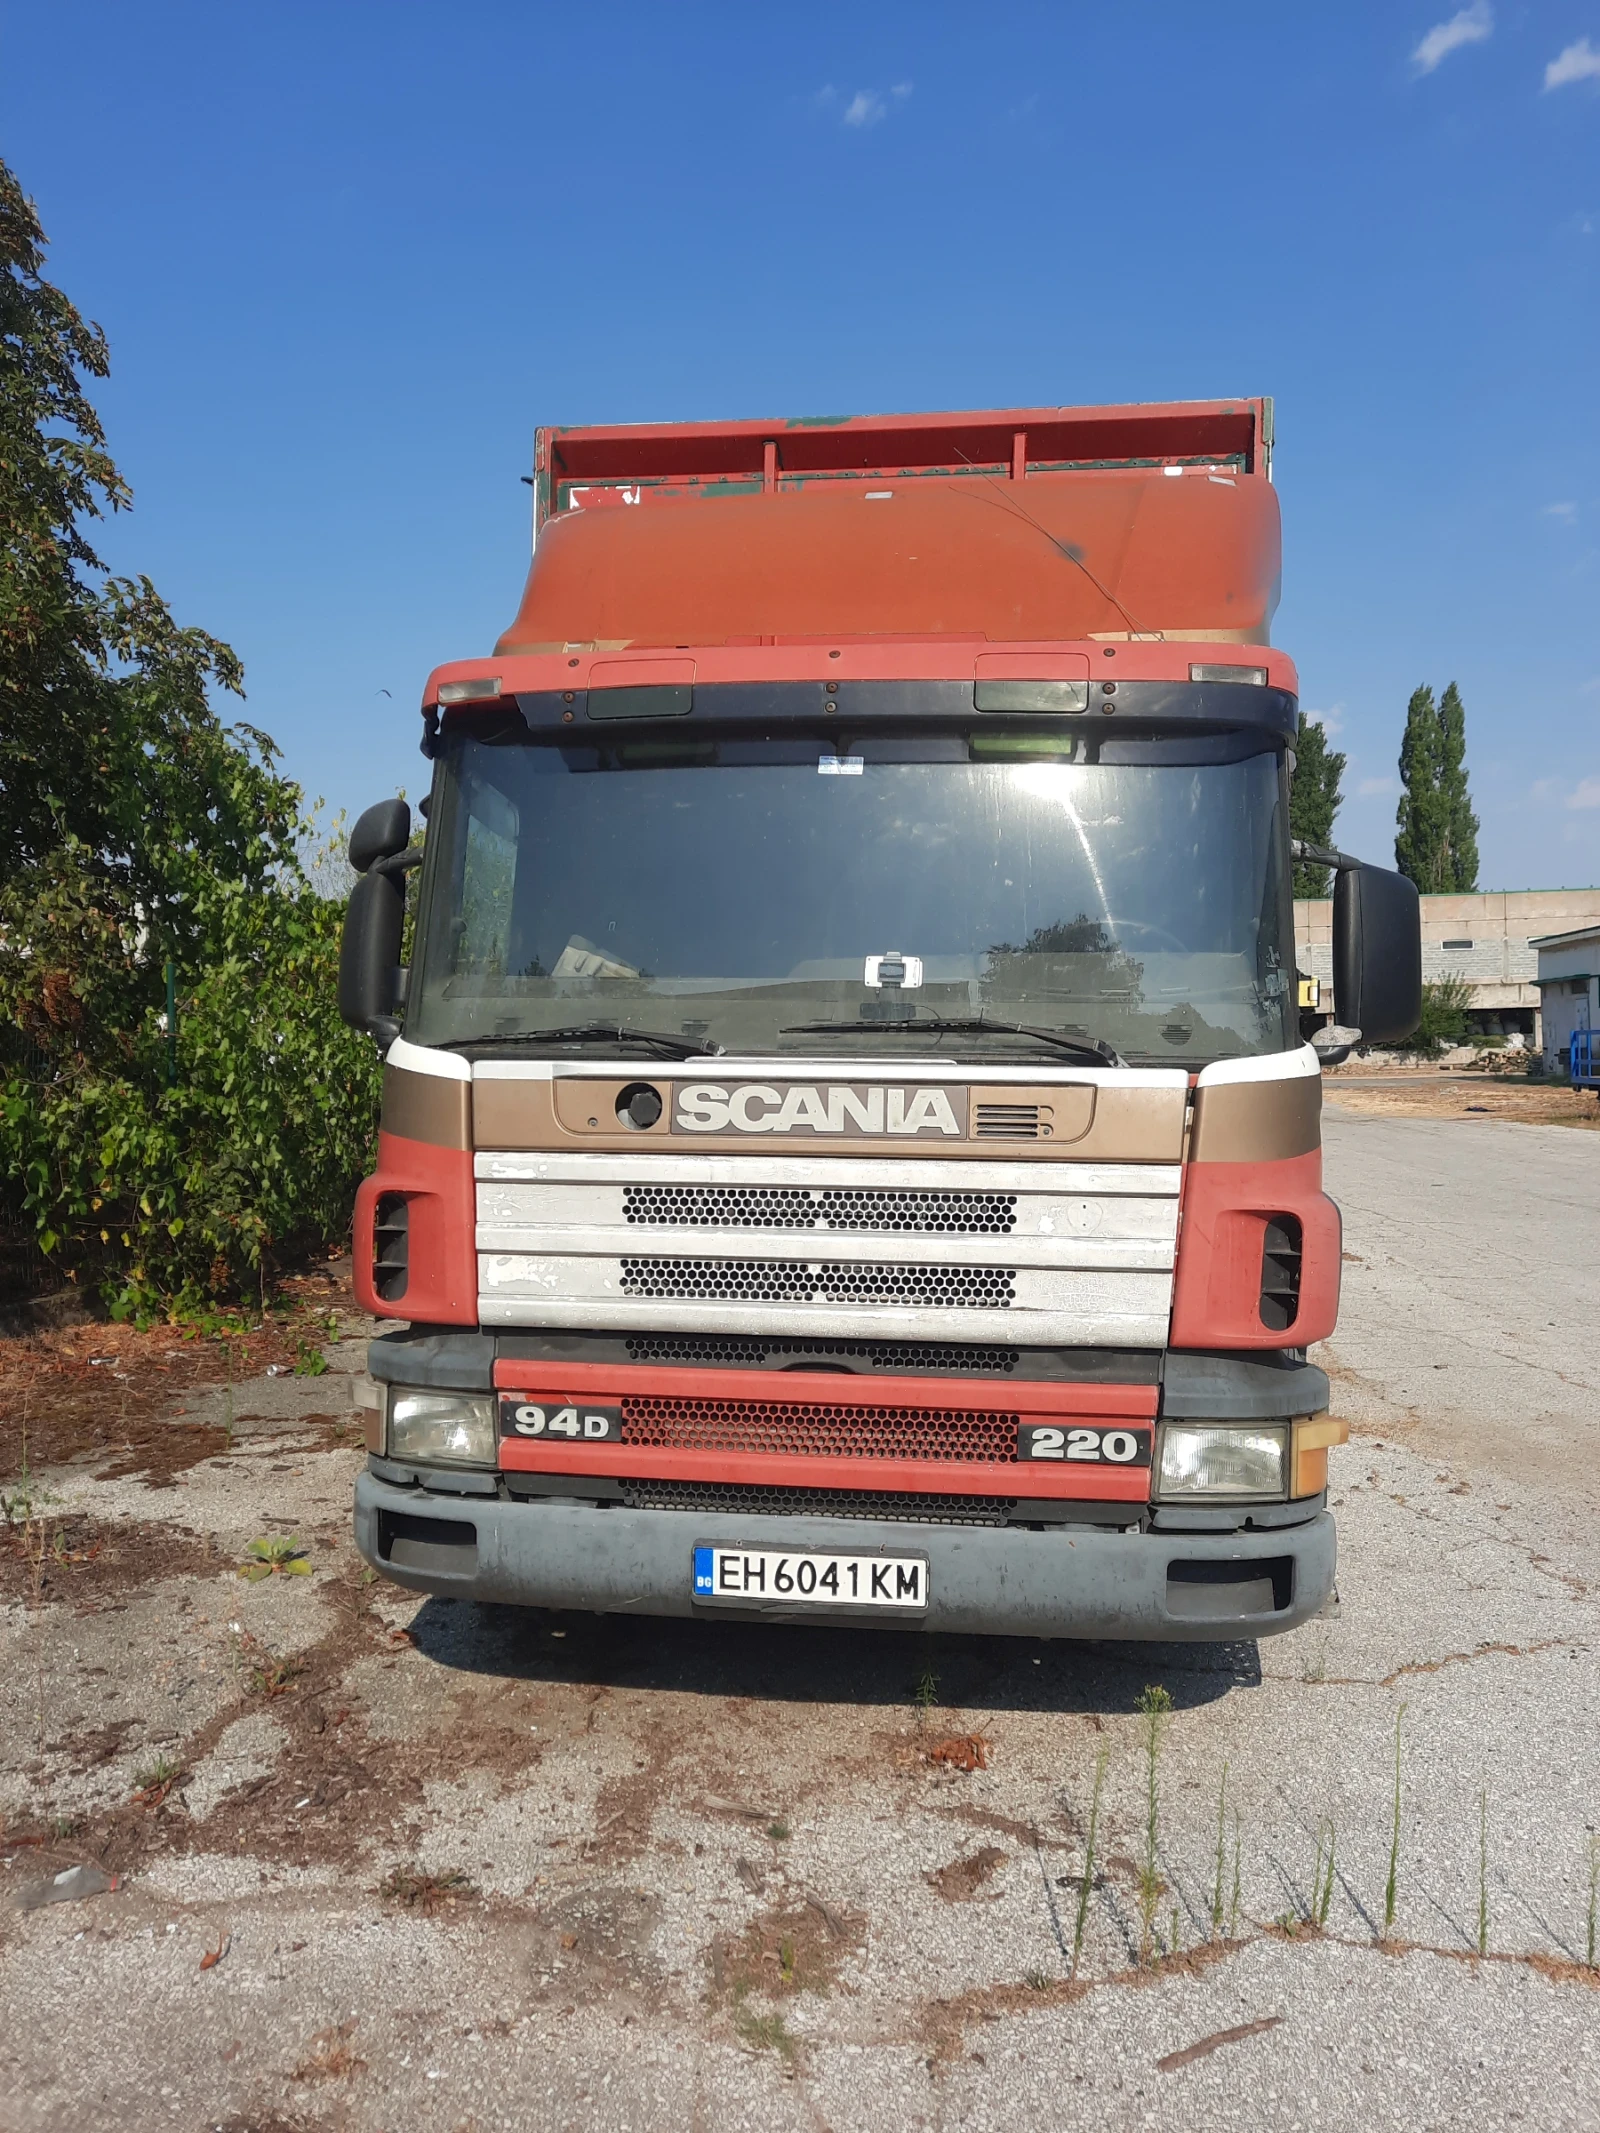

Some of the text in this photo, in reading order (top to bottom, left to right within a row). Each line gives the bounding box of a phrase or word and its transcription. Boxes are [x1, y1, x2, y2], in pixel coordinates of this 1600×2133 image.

[676, 1085, 960, 1135] SCANIA
[515, 1406, 609, 1438] 94D
[1031, 1428, 1138, 1462] 220
[696, 1576, 712, 1588] BG
